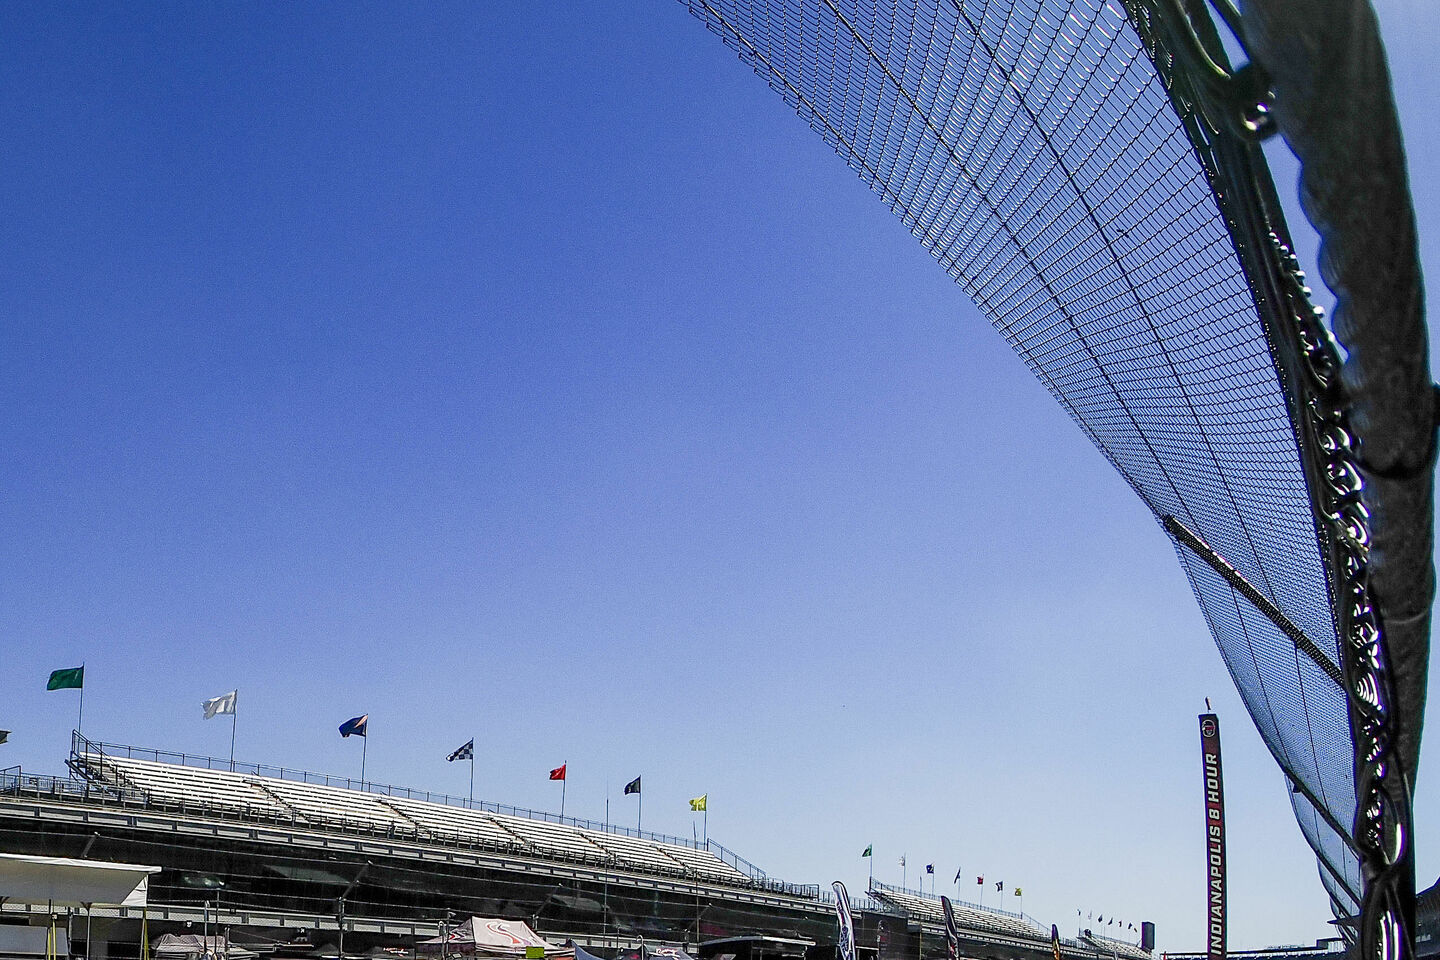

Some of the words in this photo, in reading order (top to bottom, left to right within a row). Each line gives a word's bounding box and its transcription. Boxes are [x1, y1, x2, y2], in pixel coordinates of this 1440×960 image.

[1205, 753, 1219, 802] HOUR
[1208, 809, 1220, 820] 8
[1209, 825, 1222, 955] INDIANAPOLIS
